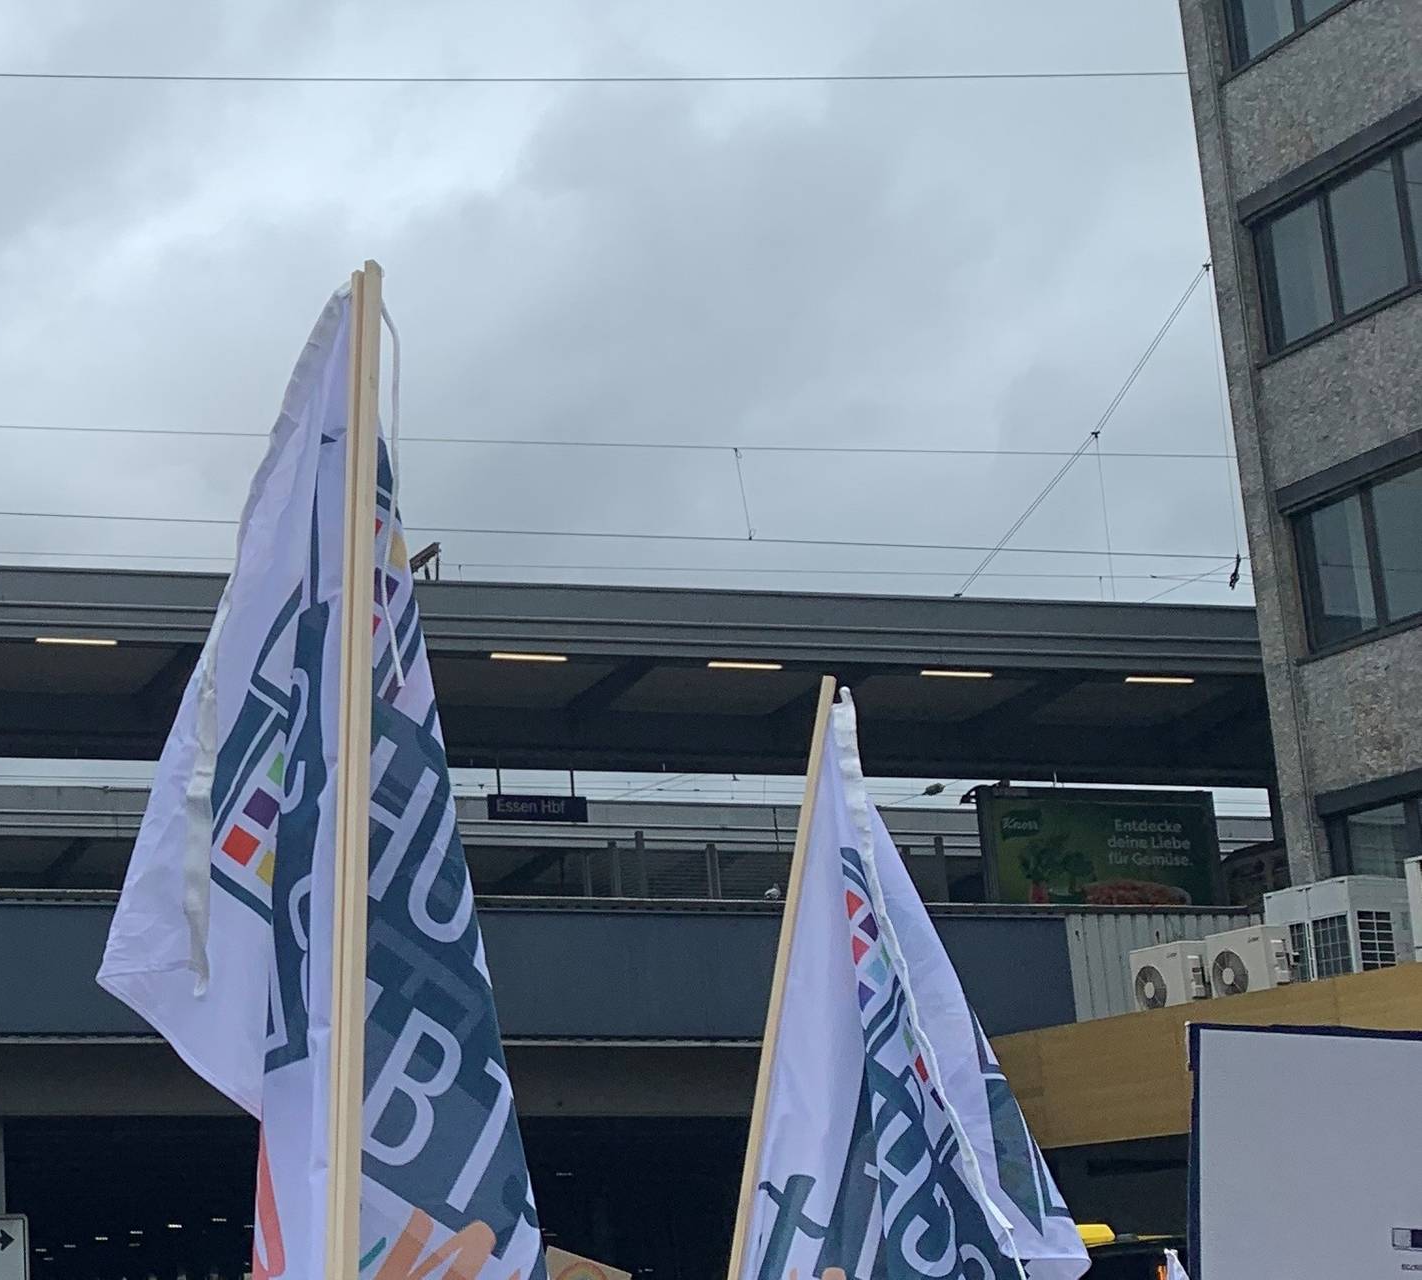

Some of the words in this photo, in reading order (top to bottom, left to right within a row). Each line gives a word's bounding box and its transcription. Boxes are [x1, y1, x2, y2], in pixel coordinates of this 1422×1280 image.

[496, 799, 538, 813] Essen
[541, 799, 565, 814] Hbf
[1114, 818, 1182, 833] Entdecke
[1107, 834, 1148, 849] deine
[1151, 835, 1191, 850] Liebe
[1108, 849, 1129, 865] für
[1131, 851, 1194, 866] Gemüse.
